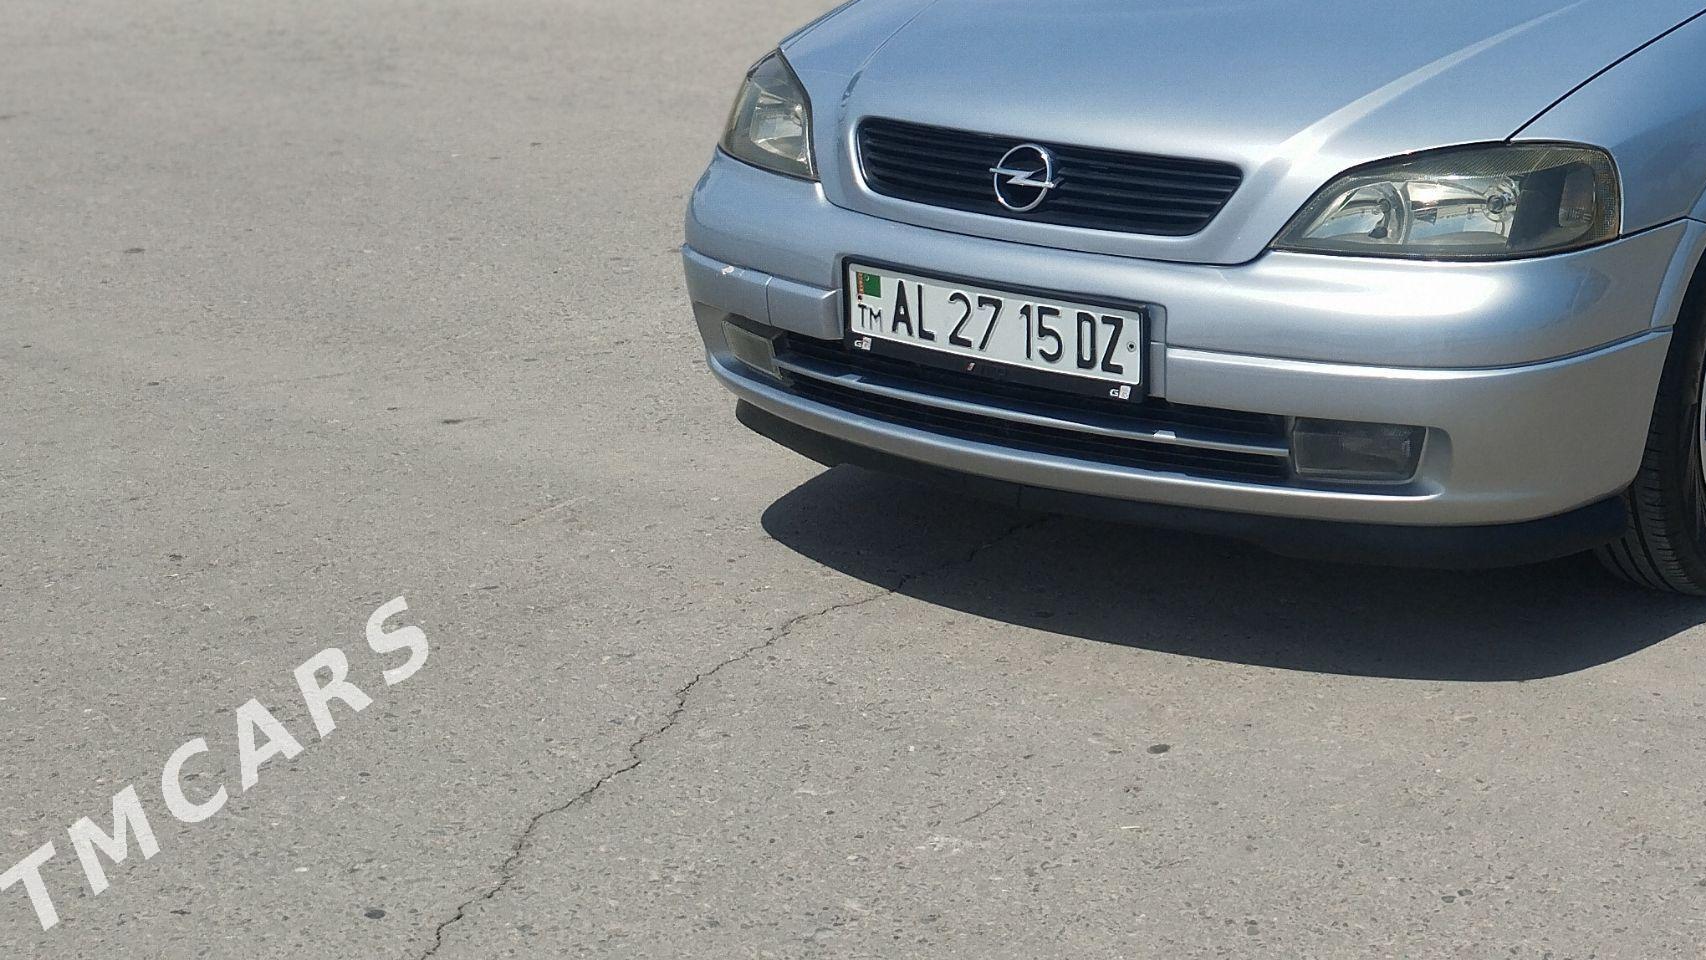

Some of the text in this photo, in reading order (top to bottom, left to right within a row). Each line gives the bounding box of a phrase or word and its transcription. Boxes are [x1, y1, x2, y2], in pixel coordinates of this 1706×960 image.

[857, 303, 882, 332] TM
[891, 280, 1124, 374] AL 27 15 DZ
